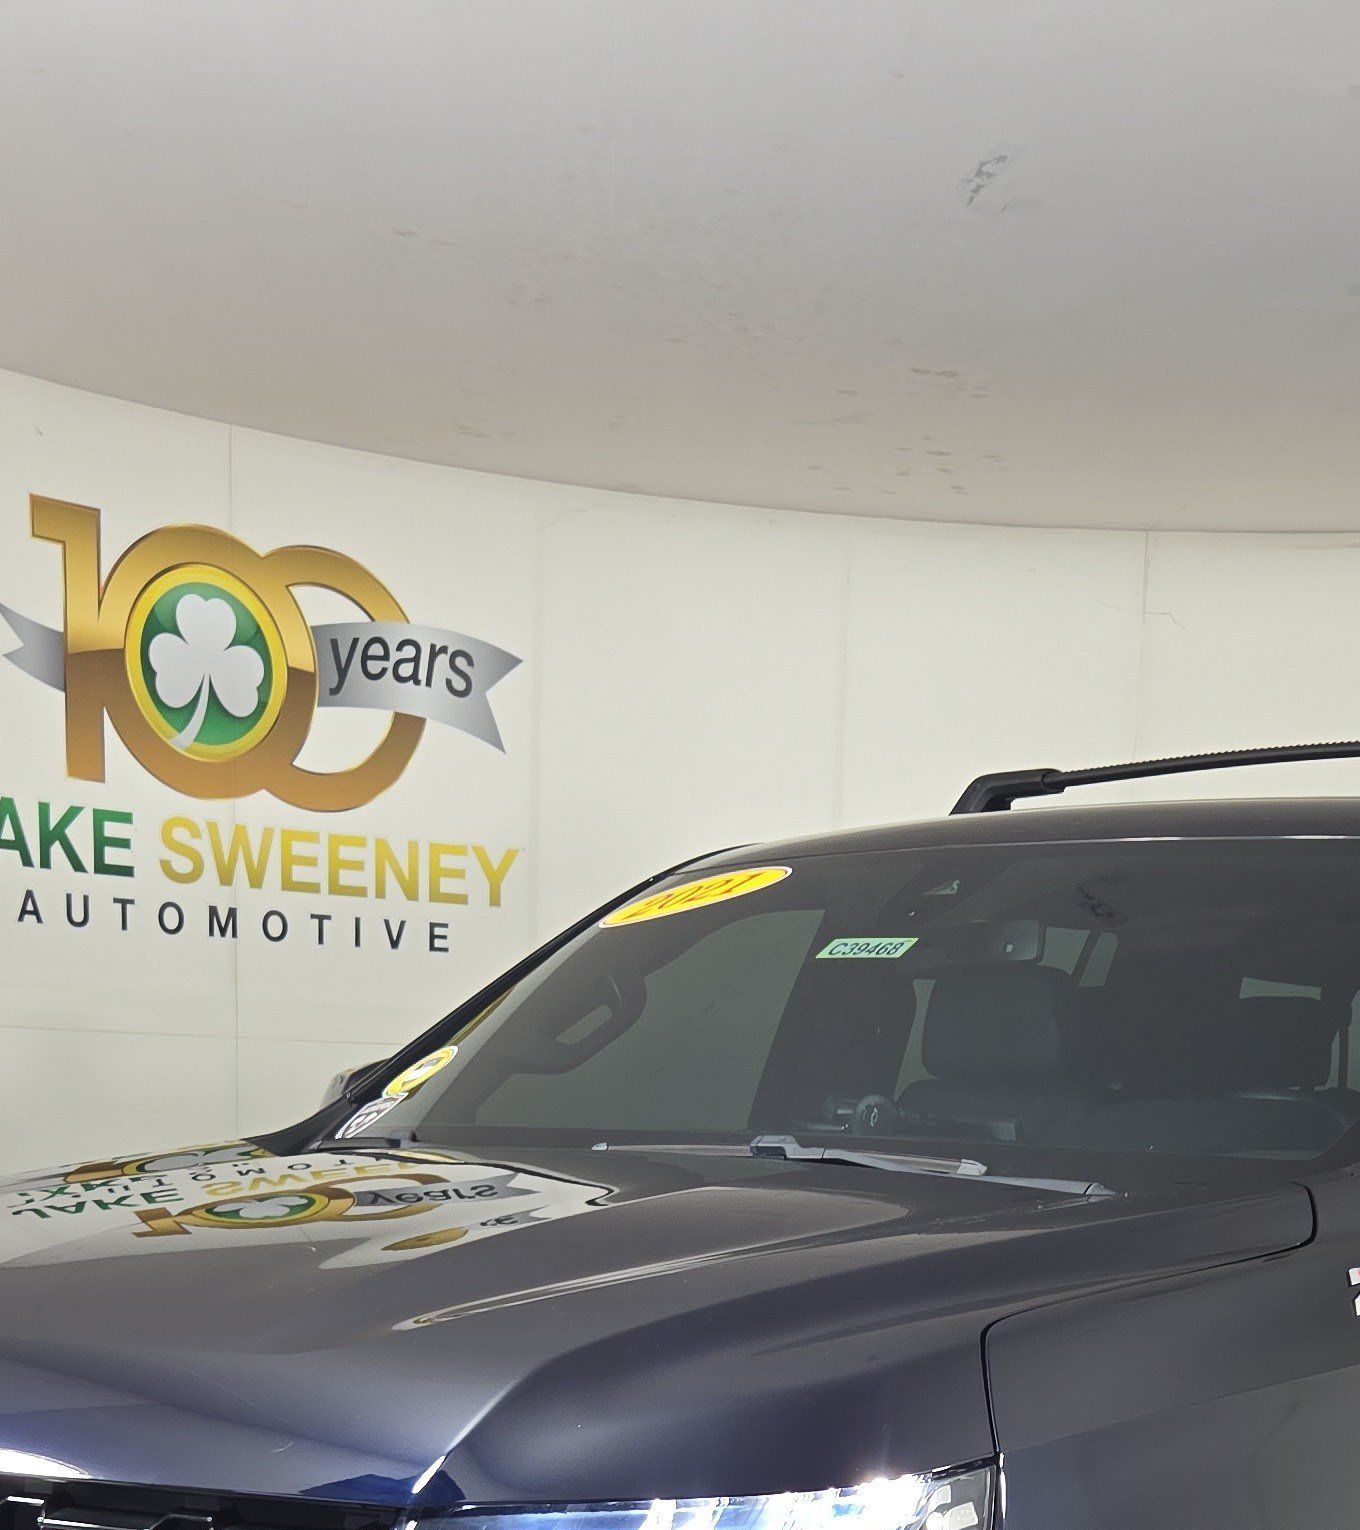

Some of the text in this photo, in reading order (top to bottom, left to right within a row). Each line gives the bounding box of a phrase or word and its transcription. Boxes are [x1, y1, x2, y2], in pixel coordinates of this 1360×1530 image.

[29, 494, 426, 811] 100
[328, 635, 475, 698] years
[159, 817, 519, 908] SWEENEY
[17, 890, 450, 952] AUTOMOTIVE
